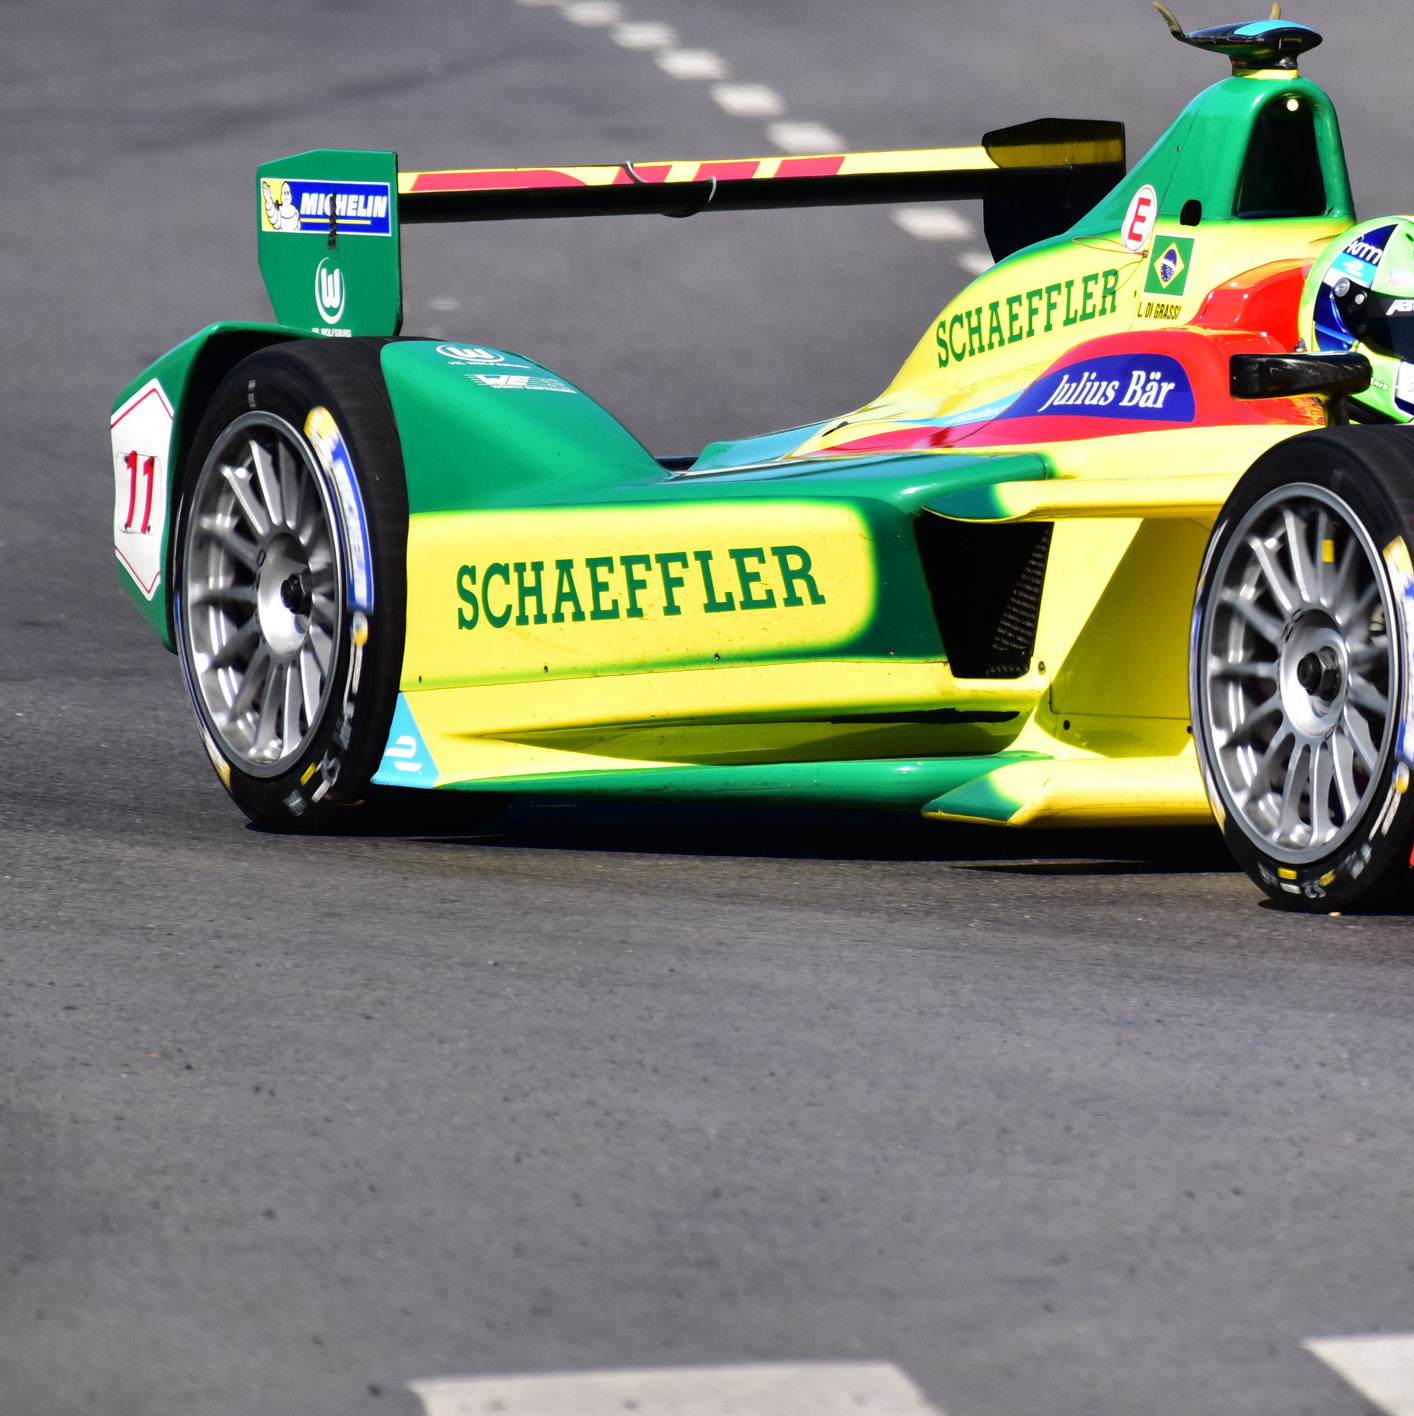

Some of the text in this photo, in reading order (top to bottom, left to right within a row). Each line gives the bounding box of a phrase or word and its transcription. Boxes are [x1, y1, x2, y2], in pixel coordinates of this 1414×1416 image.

[300, 192, 388, 219] MICHELIN
[1127, 196, 1152, 243] E
[936, 268, 1119, 369] SCHAEFFLER
[1144, 302, 1154, 319] DI
[1153, 303, 1182, 320] GRASSI
[1037, 372, 1120, 413] Julius
[1119, 370, 1176, 408] Bär
[126, 450, 156, 534] 11
[456, 544, 827, 631] SCHAEFFLER
